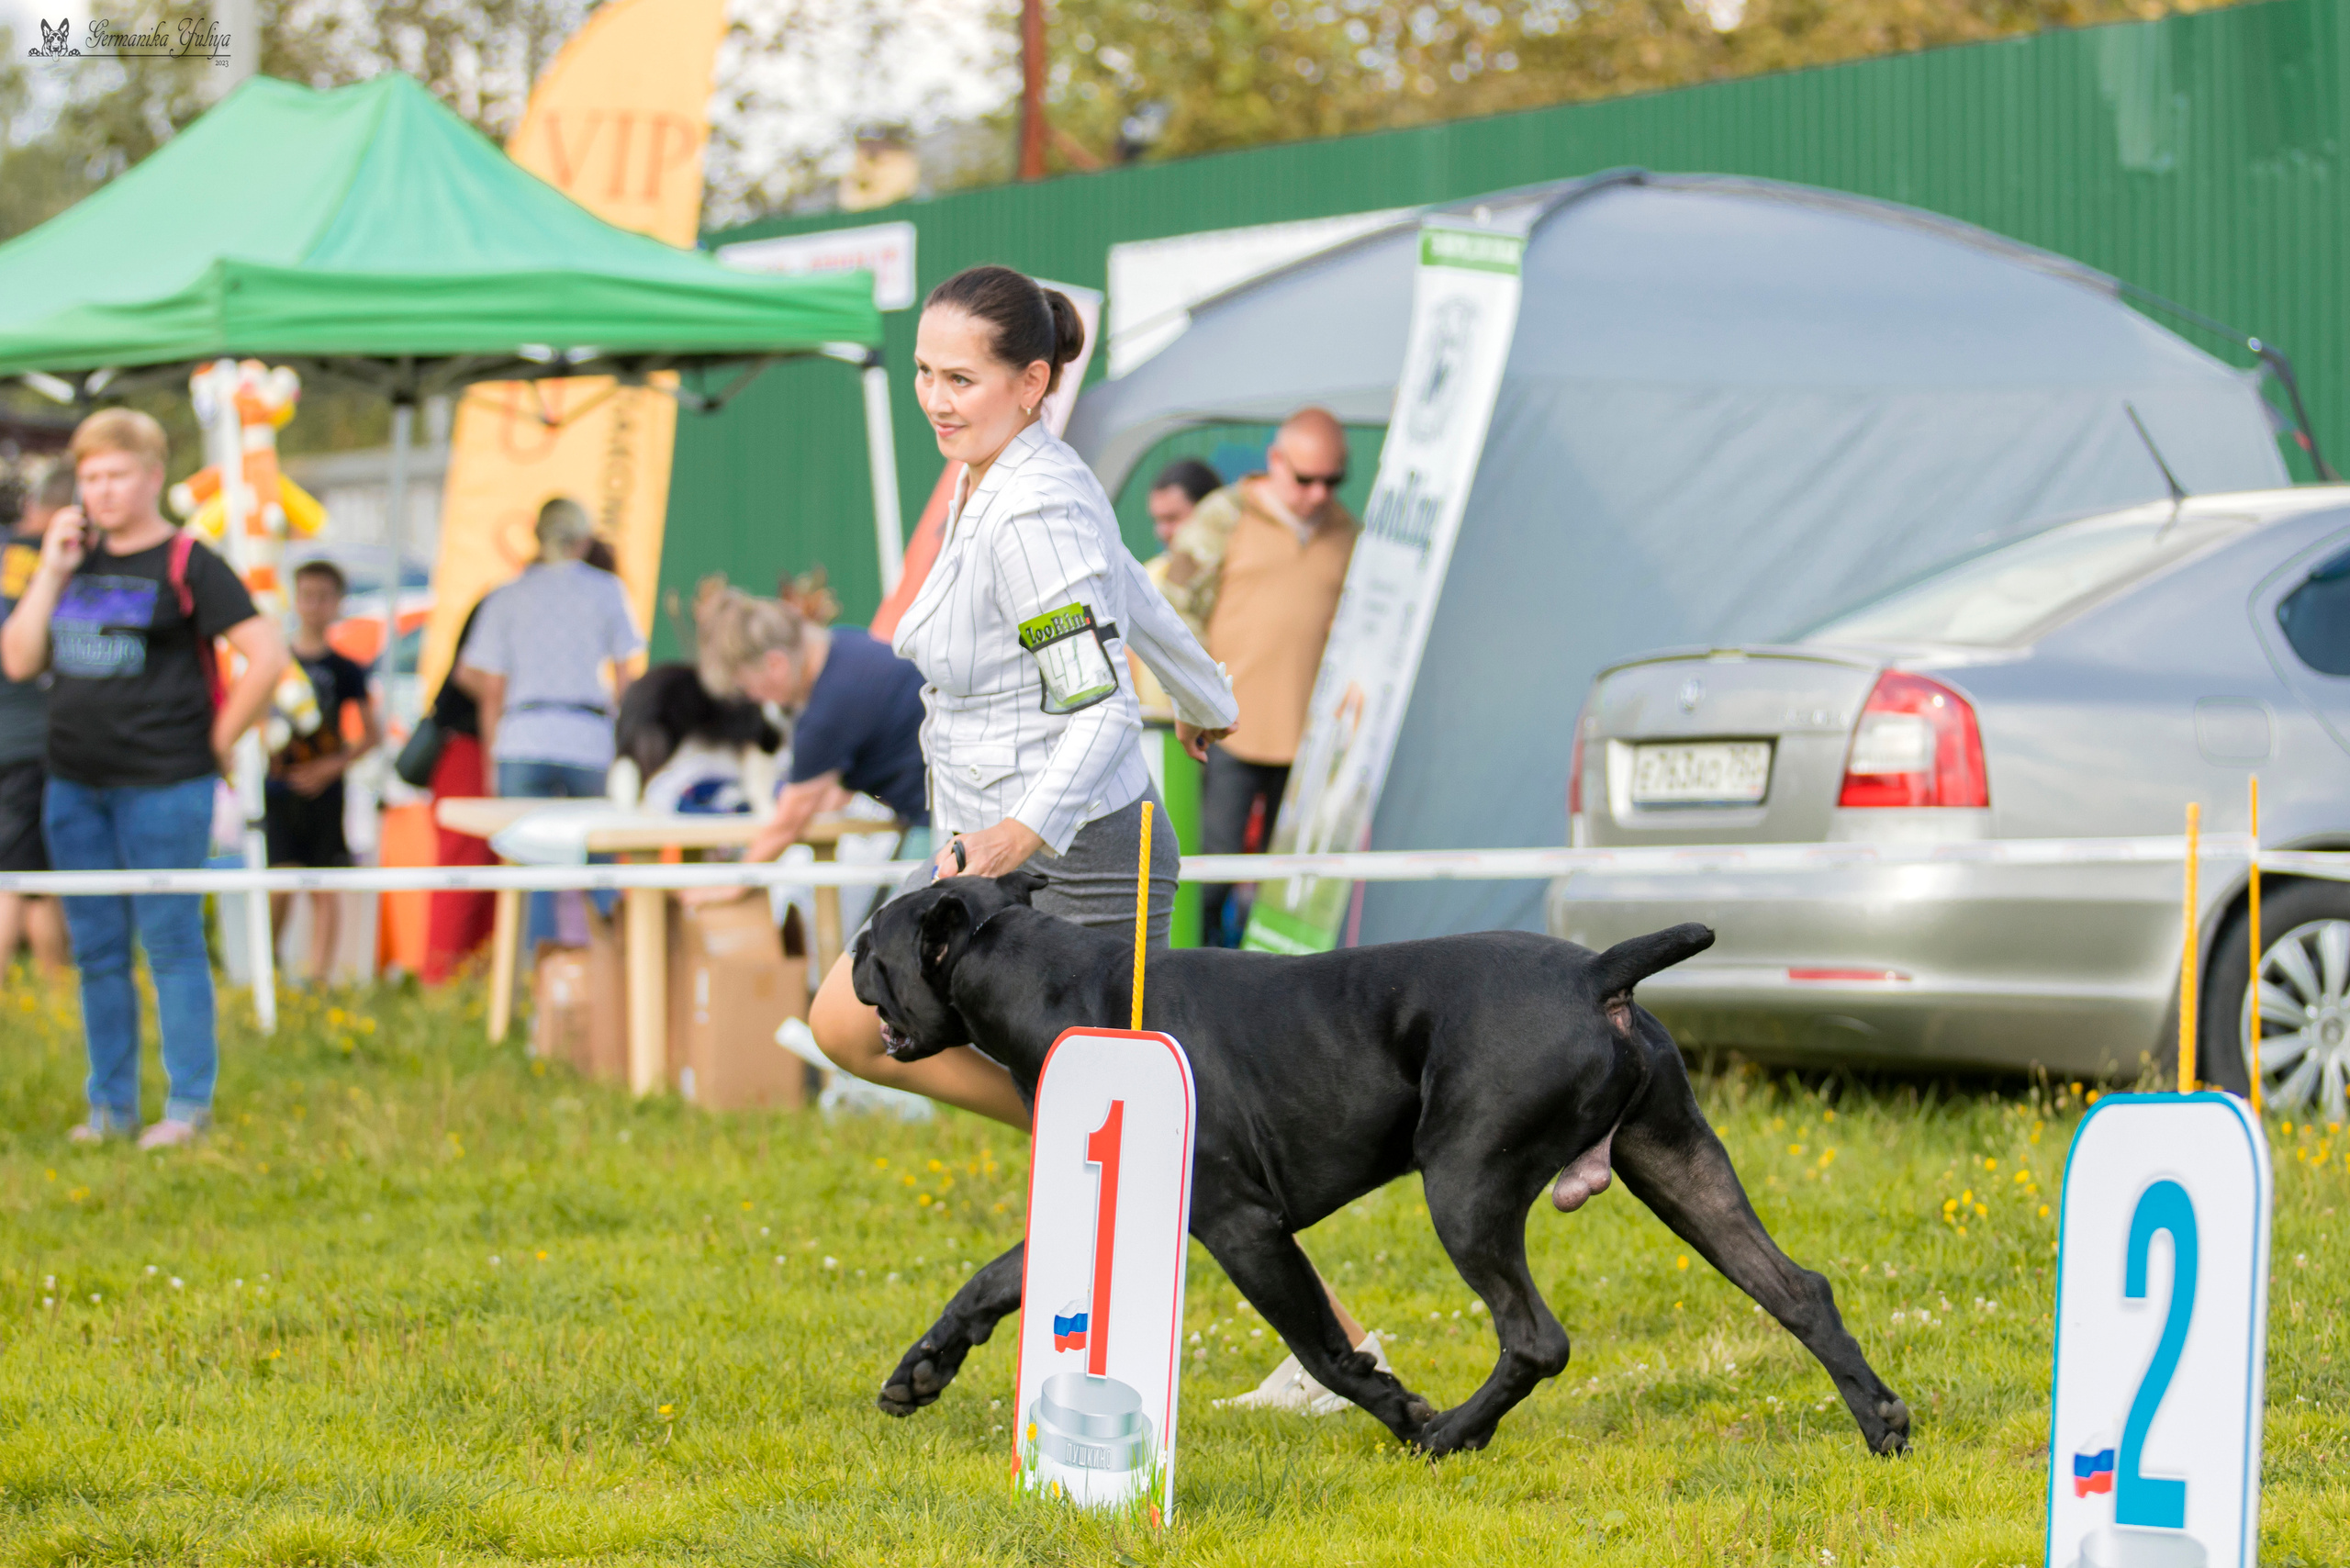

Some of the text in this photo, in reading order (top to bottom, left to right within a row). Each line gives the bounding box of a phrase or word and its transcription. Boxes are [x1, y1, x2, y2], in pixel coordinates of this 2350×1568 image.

[543, 108, 698, 203] VIP
[1086, 1099, 1125, 1379] 1
[2114, 1179, 2199, 1529] 2
[1066, 1441, 1111, 1470] ПУШКИНО
